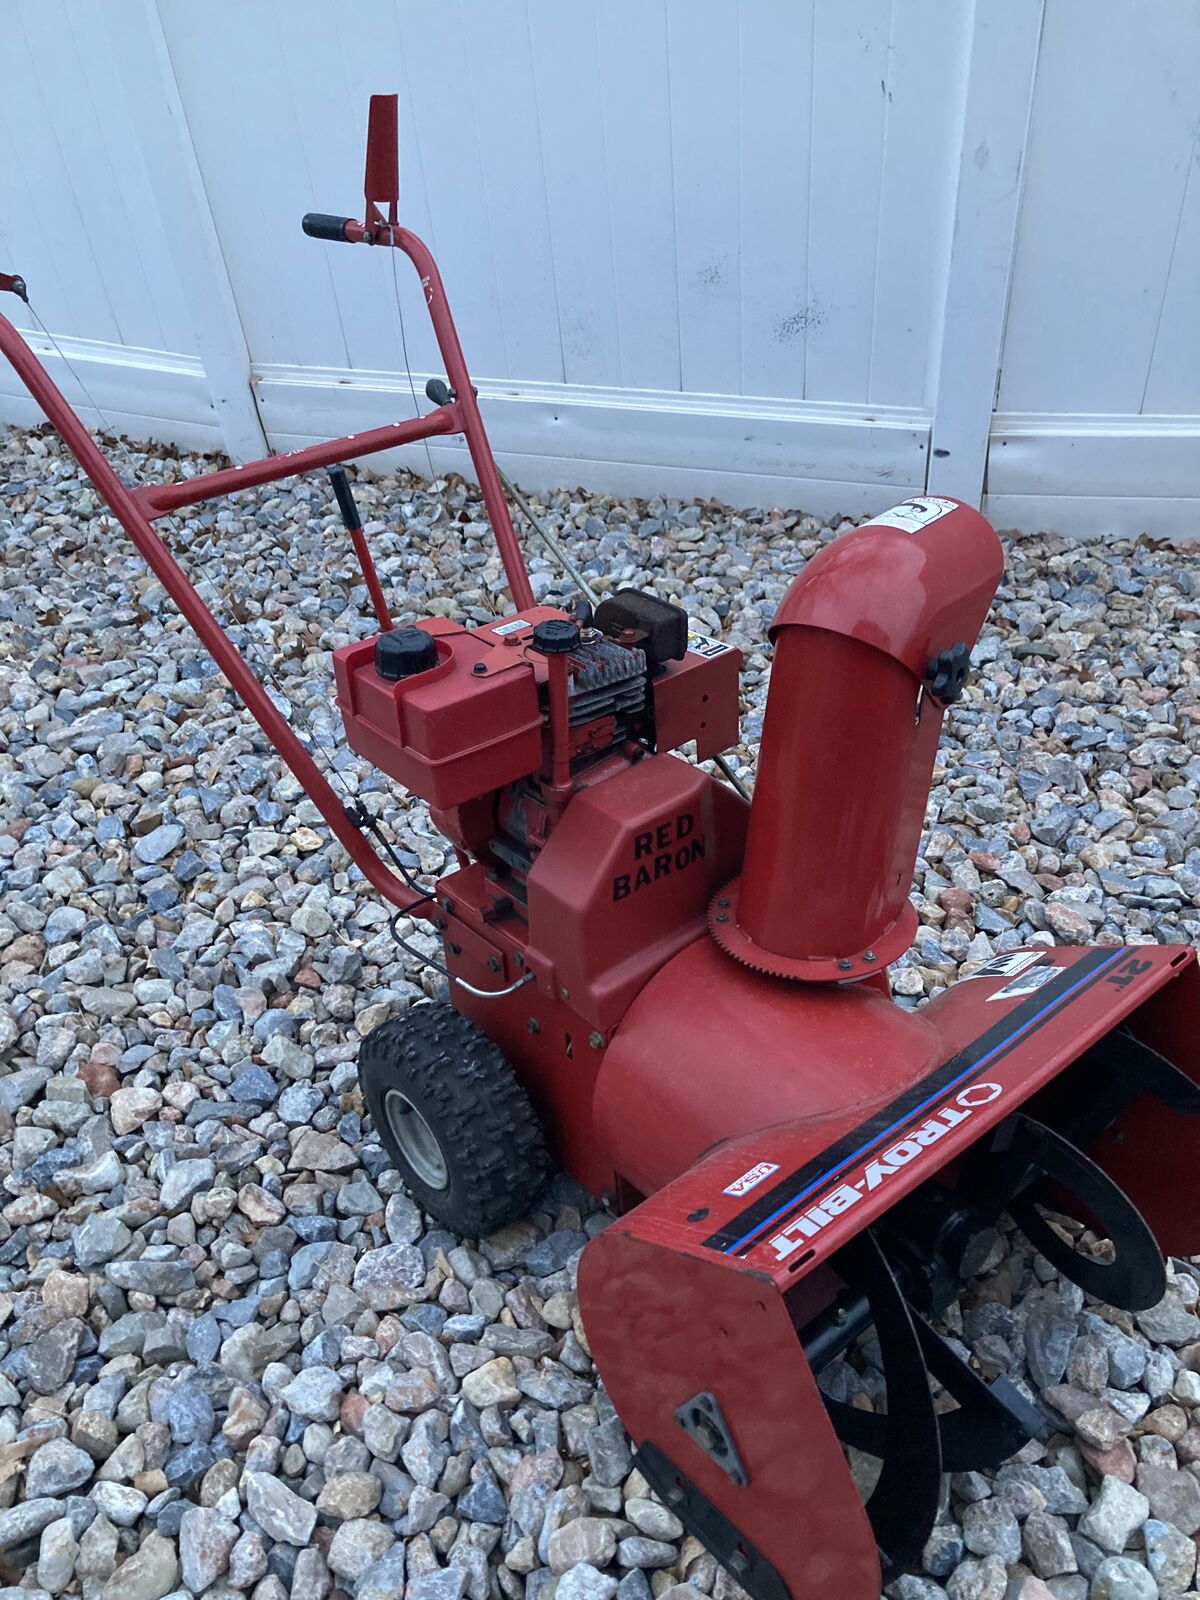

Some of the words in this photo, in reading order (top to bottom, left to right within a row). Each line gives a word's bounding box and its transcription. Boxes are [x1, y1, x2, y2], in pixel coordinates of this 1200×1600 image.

[634, 813, 694, 859] RED
[613, 833, 705, 901] BARON
[730, 1164, 773, 1191] USA
[768, 1107, 973, 1261] TROY-BILT
